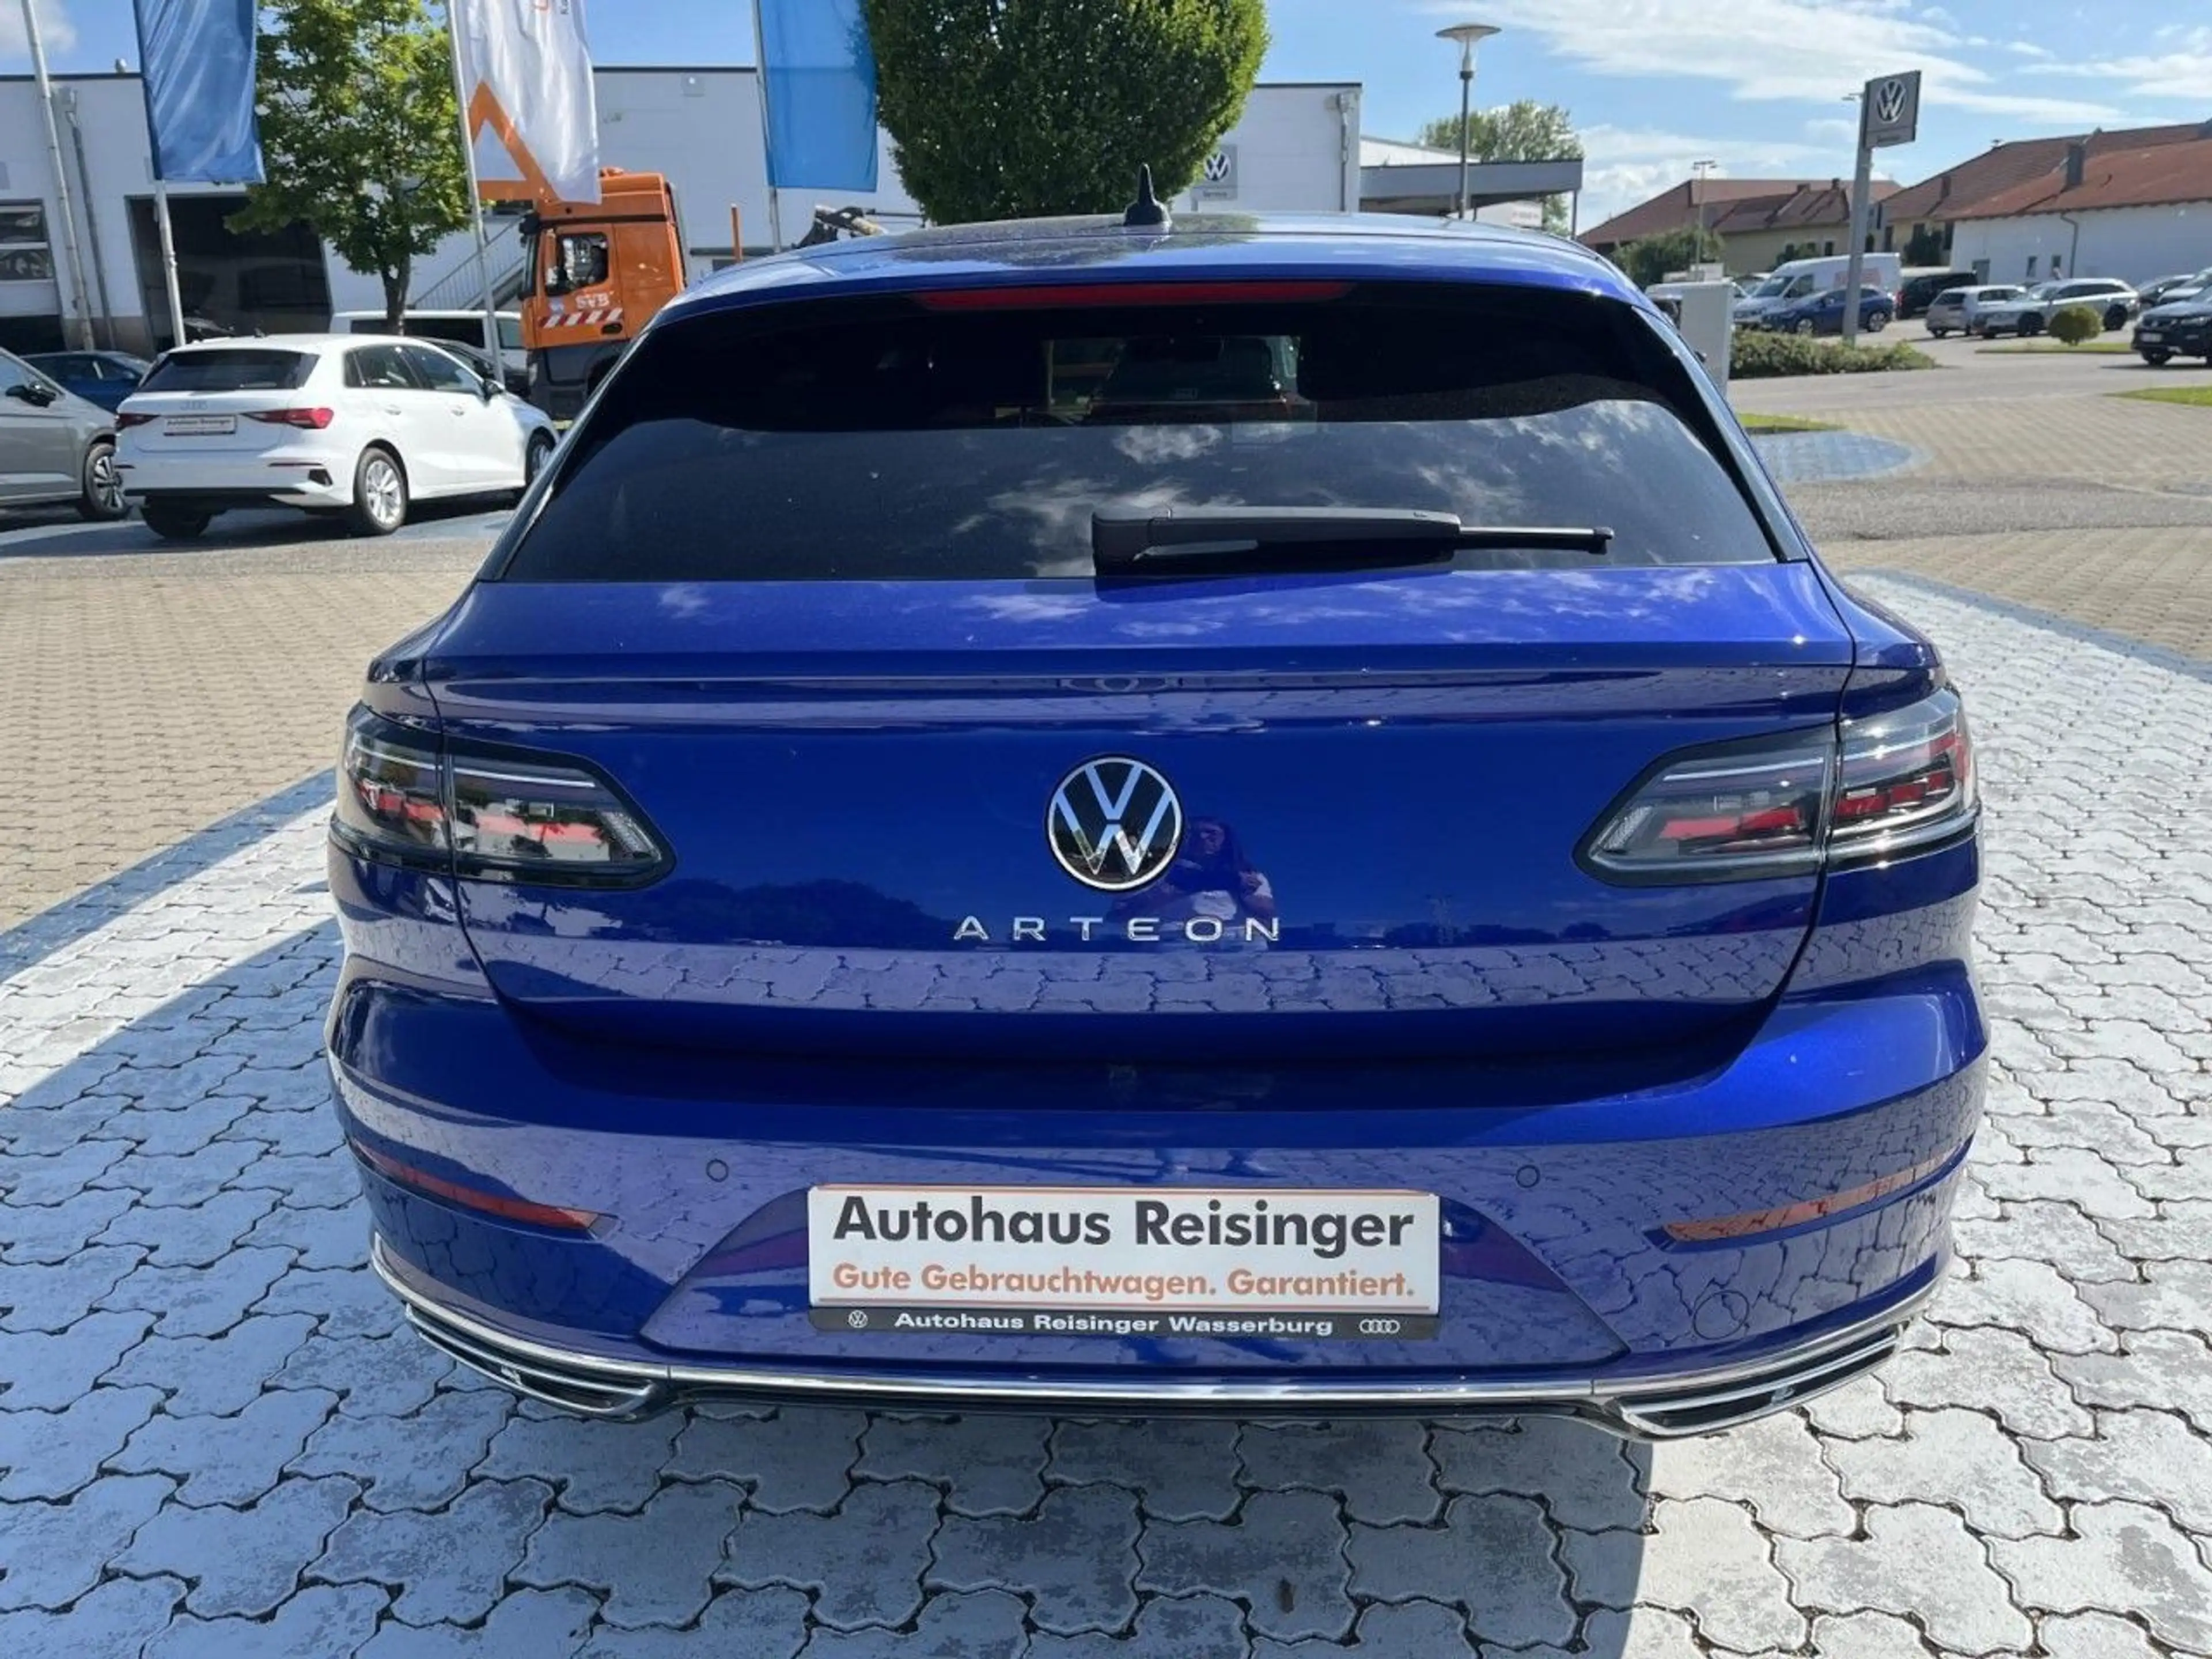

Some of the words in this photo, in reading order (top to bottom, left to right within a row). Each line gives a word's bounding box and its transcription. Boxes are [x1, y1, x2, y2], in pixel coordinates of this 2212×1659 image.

[1054, 764, 1173, 876] VW
[953, 915, 1281, 942] ARTEON
[833, 1196, 1111, 1245] Autohaus
[1135, 1199, 1414, 1258] Reisinger
[833, 1262, 911, 1289] Gute
[922, 1264, 1217, 1301] Gebrauchtwagen.
[1228, 1269, 1414, 1296] Garantiert.
[894, 1312, 1024, 1330] Autohaus
[1033, 1314, 1160, 1334] Reisinger
[1168, 1316, 1334, 1336] Wasserburg
